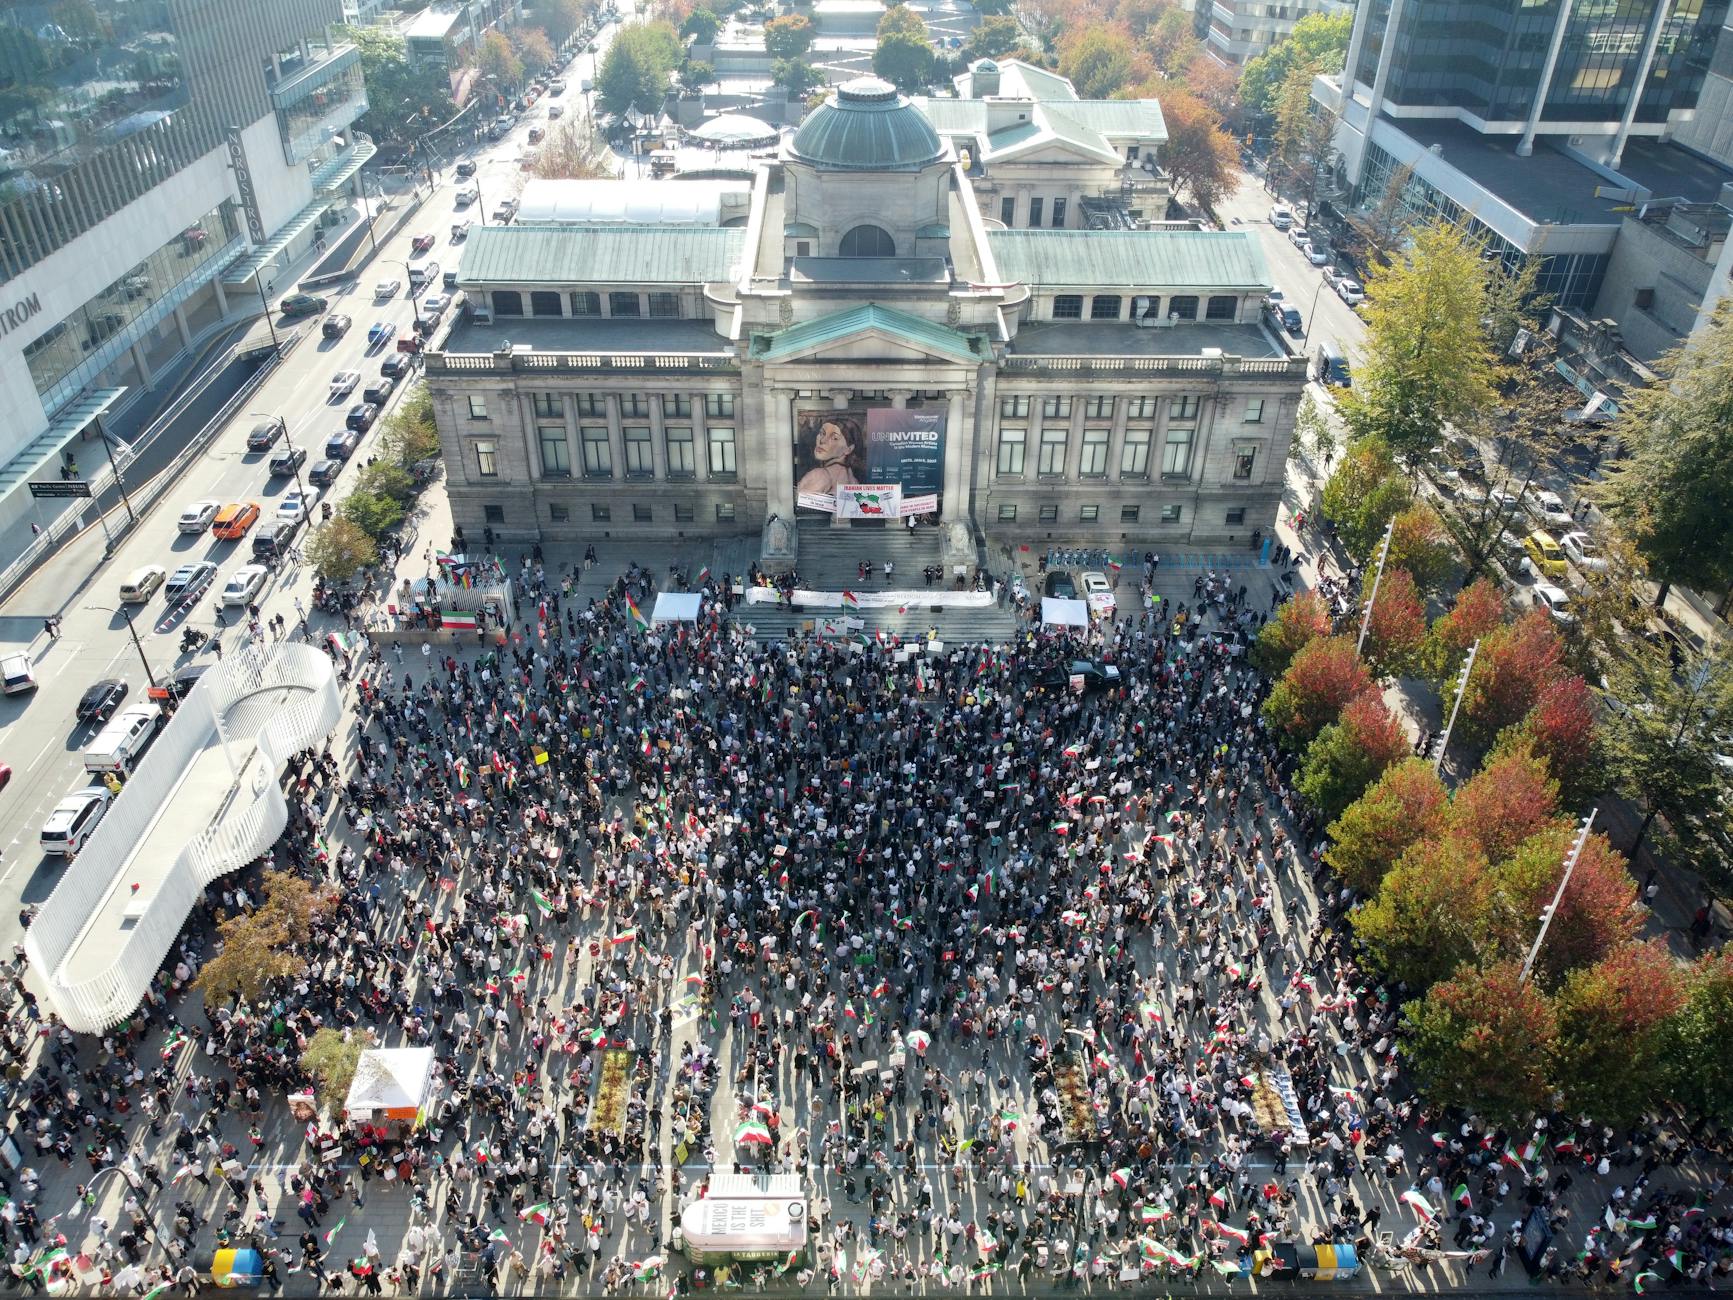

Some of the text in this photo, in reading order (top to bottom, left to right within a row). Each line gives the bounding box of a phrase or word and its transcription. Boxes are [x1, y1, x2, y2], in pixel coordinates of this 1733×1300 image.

[228, 132, 263, 241] NORDSTROM
[0, 292, 42, 342] TROM
[871, 431, 939, 442] UNINVITED
[712, 1203, 728, 1235] MEXICO
[730, 1205, 747, 1232] IS THE
[749, 1208, 765, 1228] SHIT
